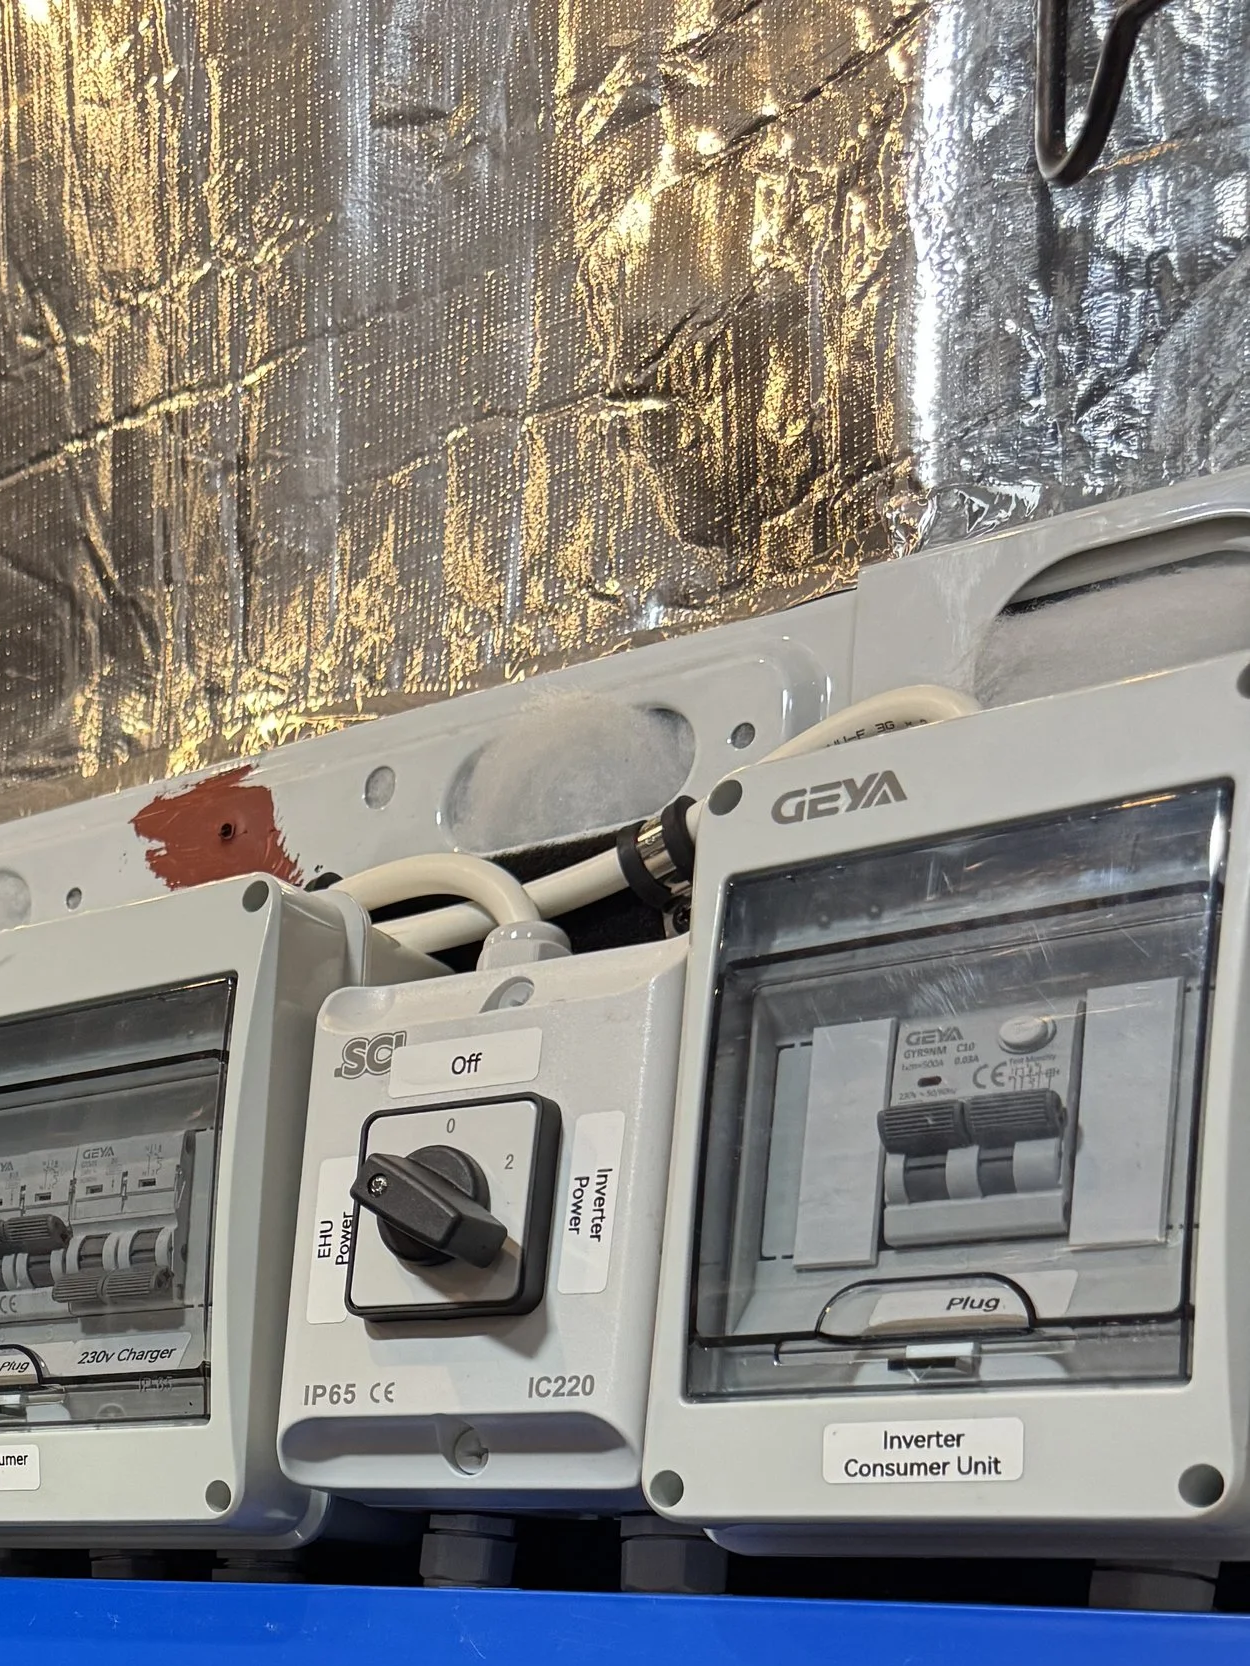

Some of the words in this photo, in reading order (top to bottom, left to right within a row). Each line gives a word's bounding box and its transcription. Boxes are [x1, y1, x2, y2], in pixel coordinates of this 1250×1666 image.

[770, 770, 908, 824] GEYA
[905, 1026, 964, 1046] GEYA
[452, 1053, 482, 1075] Off
[446, 1118, 455, 1134] 0
[84, 1146, 115, 1160] GEYA
[505, 1153, 514, 1170] 2
[568, 1176, 589, 1235] Power
[590, 1168, 613, 1242] Inverter
[318, 1220, 332, 1259] EHU
[336, 1211, 353, 1266] Power
[946, 1296, 1000, 1312] Plug
[77, 1350, 115, 1365] 230v
[117, 1346, 177, 1365] Charger
[0, 1361, 30, 1373] Plug
[303, 1384, 356, 1406] IP65
[527, 1374, 596, 1399] IC220
[883, 1430, 965, 1450] Inverter
[844, 1458, 950, 1478] Consumer
[957, 1455, 1002, 1476] Unit
